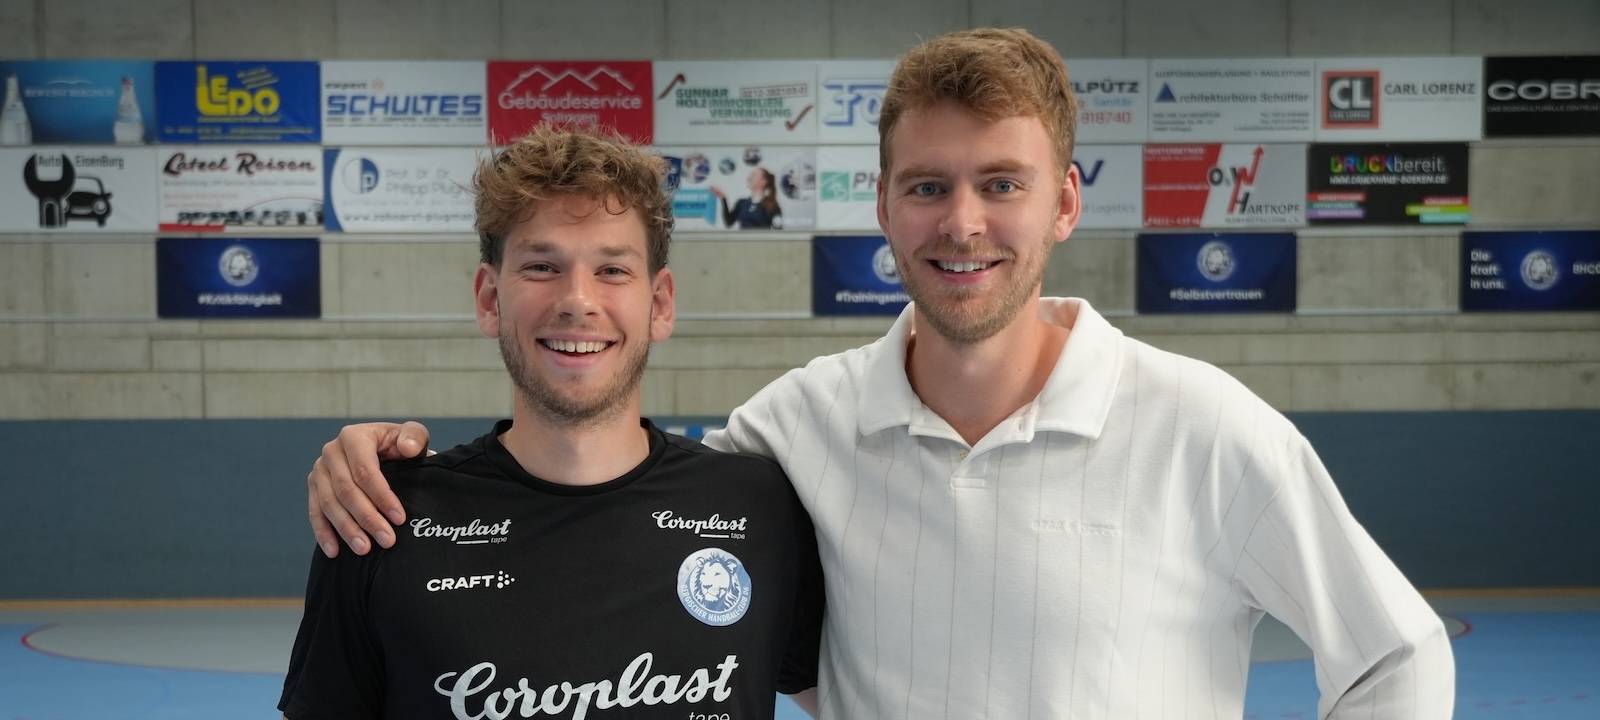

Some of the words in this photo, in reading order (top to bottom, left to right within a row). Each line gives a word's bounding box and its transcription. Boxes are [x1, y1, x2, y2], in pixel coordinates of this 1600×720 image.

[196, 65, 280, 116] LEDO
[675, 88, 729, 98] GUNNAR
[1071, 78, 1139, 94] LPÜTZ
[1329, 78, 1371, 109] CL
[1385, 84, 1418, 96] CARL
[1422, 83, 1476, 95] LORENZ
[1487, 81, 1600, 100] COBR
[327, 95, 482, 115] SCHULTES
[499, 92, 641, 110] Gebäudeservice
[676, 99, 706, 109] HOLZ
[710, 98, 783, 109] IMMOBILIEN
[711, 109, 792, 119] VERWALTUNG
[163, 152, 230, 176] Latzel
[236, 152, 315, 175] Reisen
[1470, 250, 1490, 261] Die
[1470, 264, 1499, 275] Kraft
[1169, 288, 1263, 300] #Selbstvertrauen
[409, 518, 511, 541] Coroplast
[651, 510, 747, 534] Coroplast
[426, 575, 495, 592] CRAFT
[434, 652, 739, 720] Coroplast
